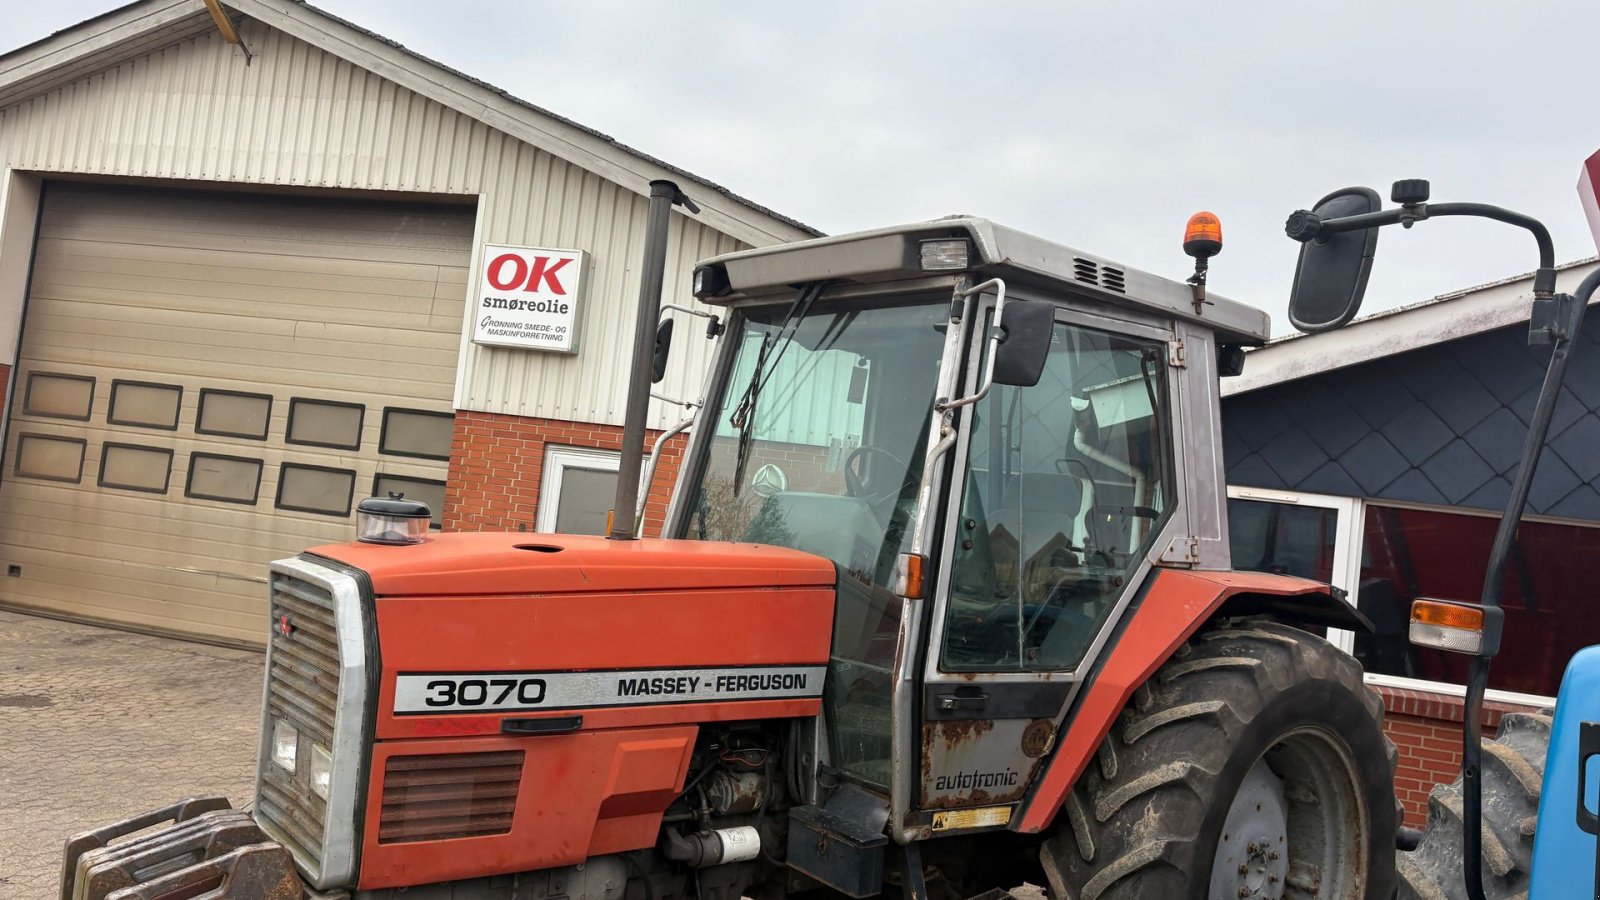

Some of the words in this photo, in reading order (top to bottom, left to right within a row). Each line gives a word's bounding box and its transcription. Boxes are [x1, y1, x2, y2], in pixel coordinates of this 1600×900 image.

[487, 253, 574, 295] OK
[482, 297, 569, 314] smøreolie
[487, 328, 563, 342] MASKINFORRETNING
[524, 323, 553, 333] SMEDE-
[555, 326, 567, 334] OG
[425, 679, 547, 706] 3070
[936, 767, 1018, 790] autotronic
